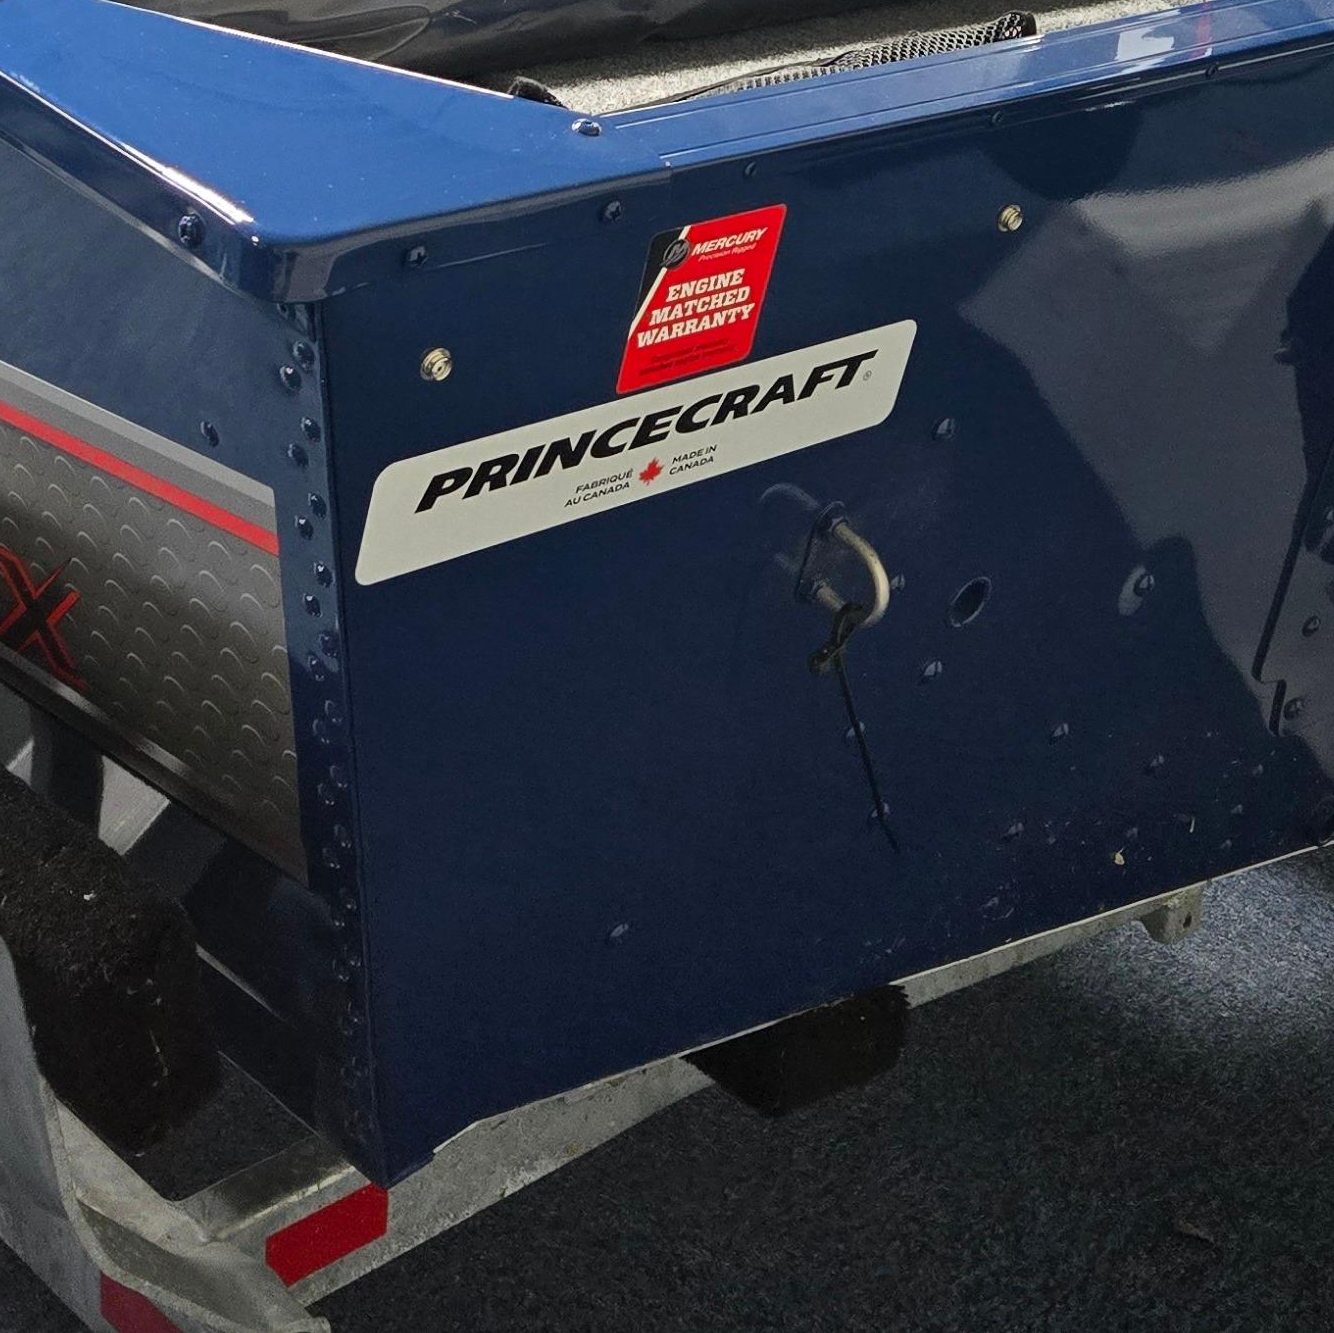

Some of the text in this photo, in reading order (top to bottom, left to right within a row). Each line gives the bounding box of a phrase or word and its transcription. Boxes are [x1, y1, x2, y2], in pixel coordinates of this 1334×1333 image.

[691, 227, 768, 256] MERCURY
[666, 268, 745, 302] ENGINE
[649, 286, 750, 326] MATCHED
[637, 303, 755, 348] WARRANTY
[414, 349, 878, 514] PRINCECRAFT
[669, 455, 714, 475] CANADA
[671, 444, 717, 465] MADE IN
[564, 481, 630, 508] AU CANADA
[575, 468, 633, 494] FABRIQUÉ
